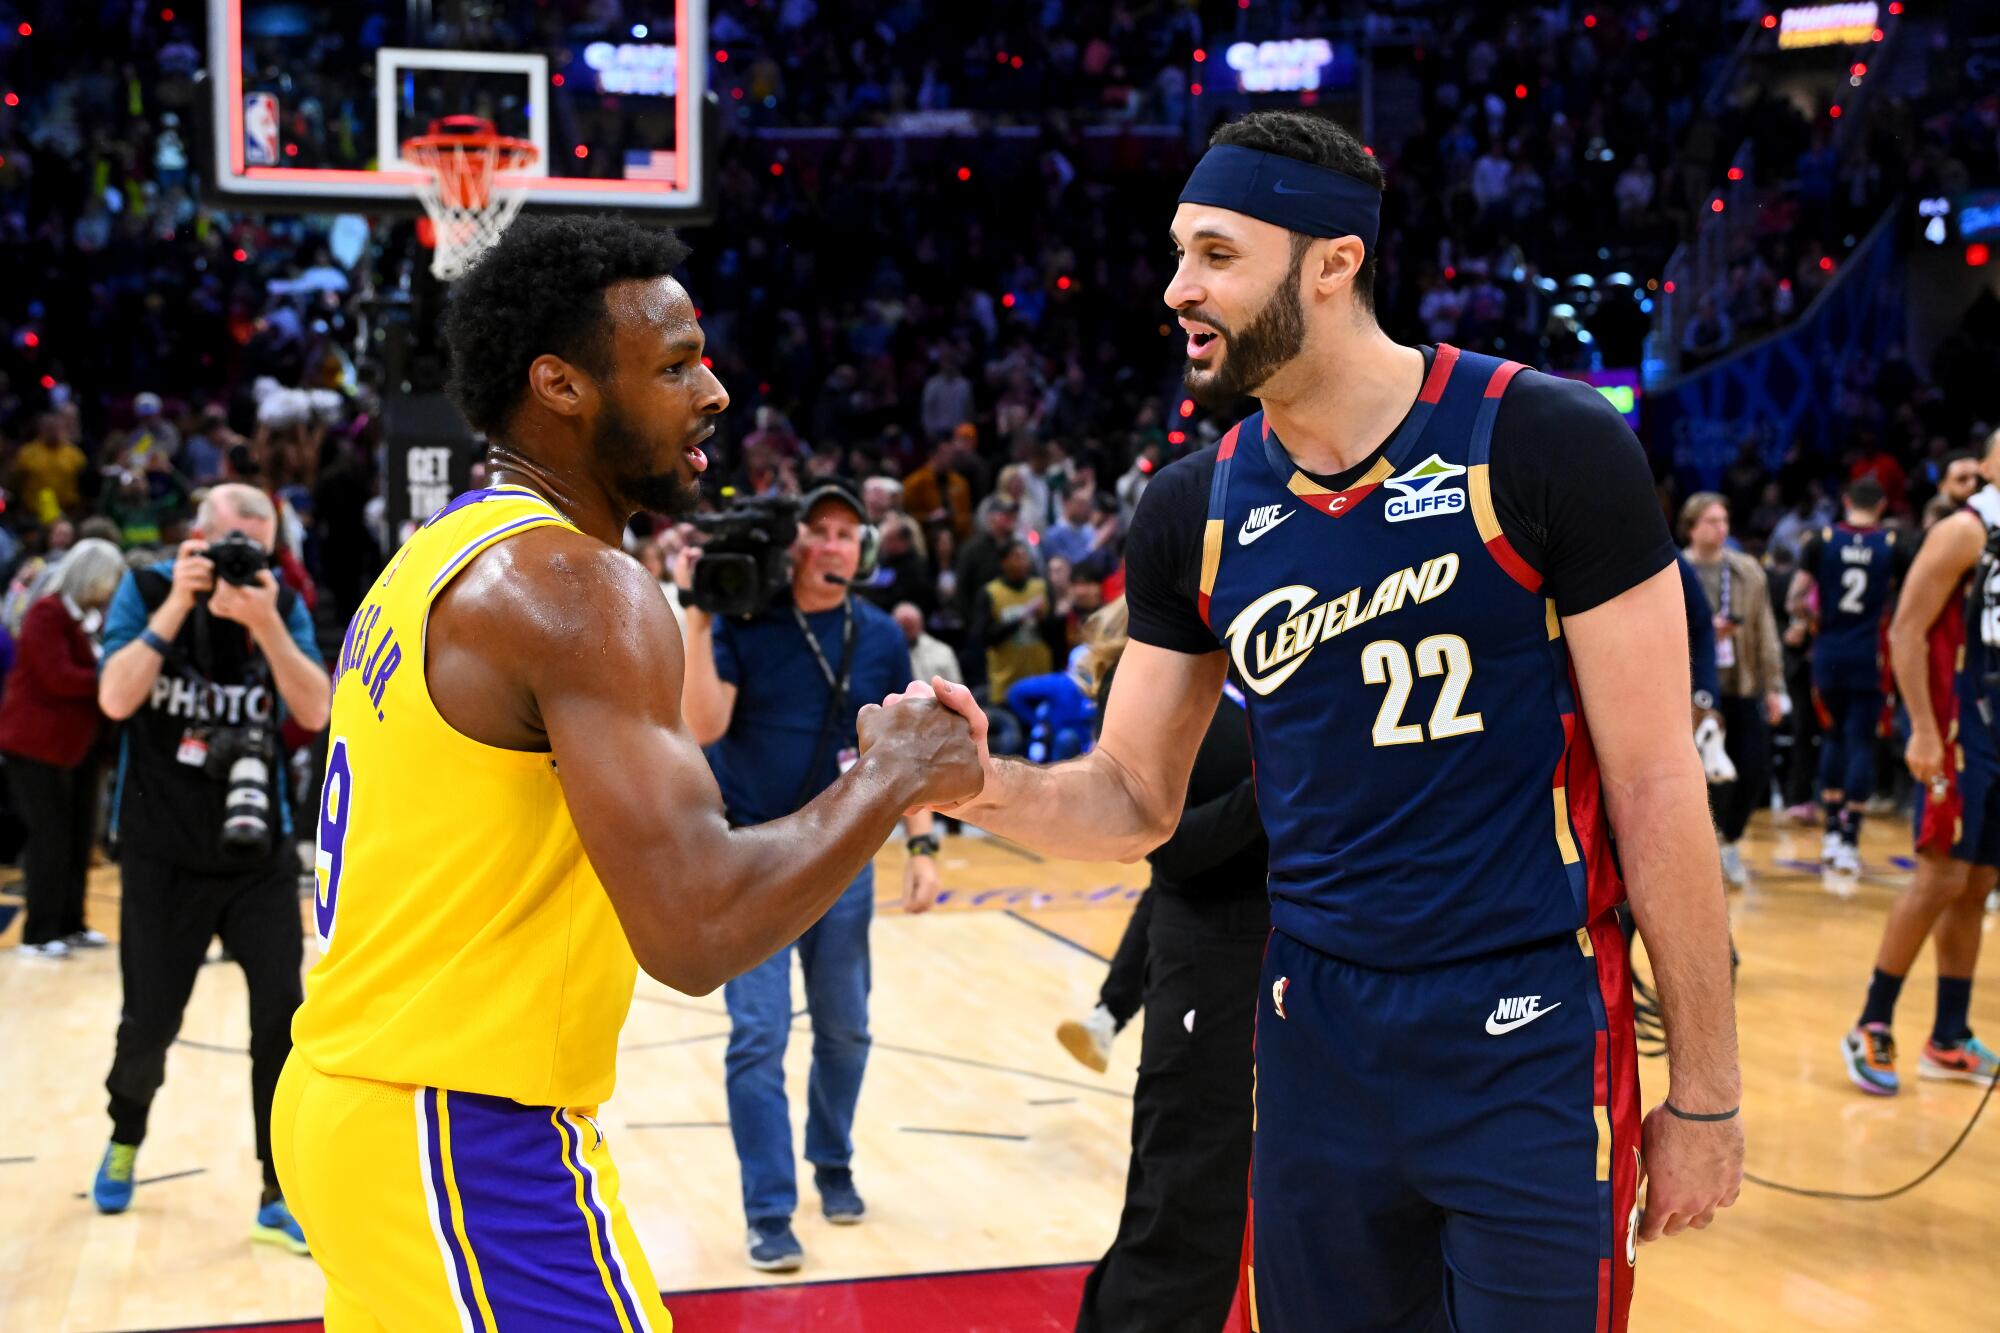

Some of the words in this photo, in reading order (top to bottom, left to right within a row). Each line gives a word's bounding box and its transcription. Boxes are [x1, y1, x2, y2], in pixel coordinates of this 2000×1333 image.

[1246, 504, 1282, 530] NIKE
[1387, 493, 1463, 517] CLIFFS
[1838, 567, 1868, 615] 2
[1224, 552, 1460, 696] CLEVELAND
[362, 625, 402, 723] JR.
[1360, 633, 1485, 747] 22
[150, 674, 273, 724] PHOTO
[1495, 995, 1542, 1020] NIKE
